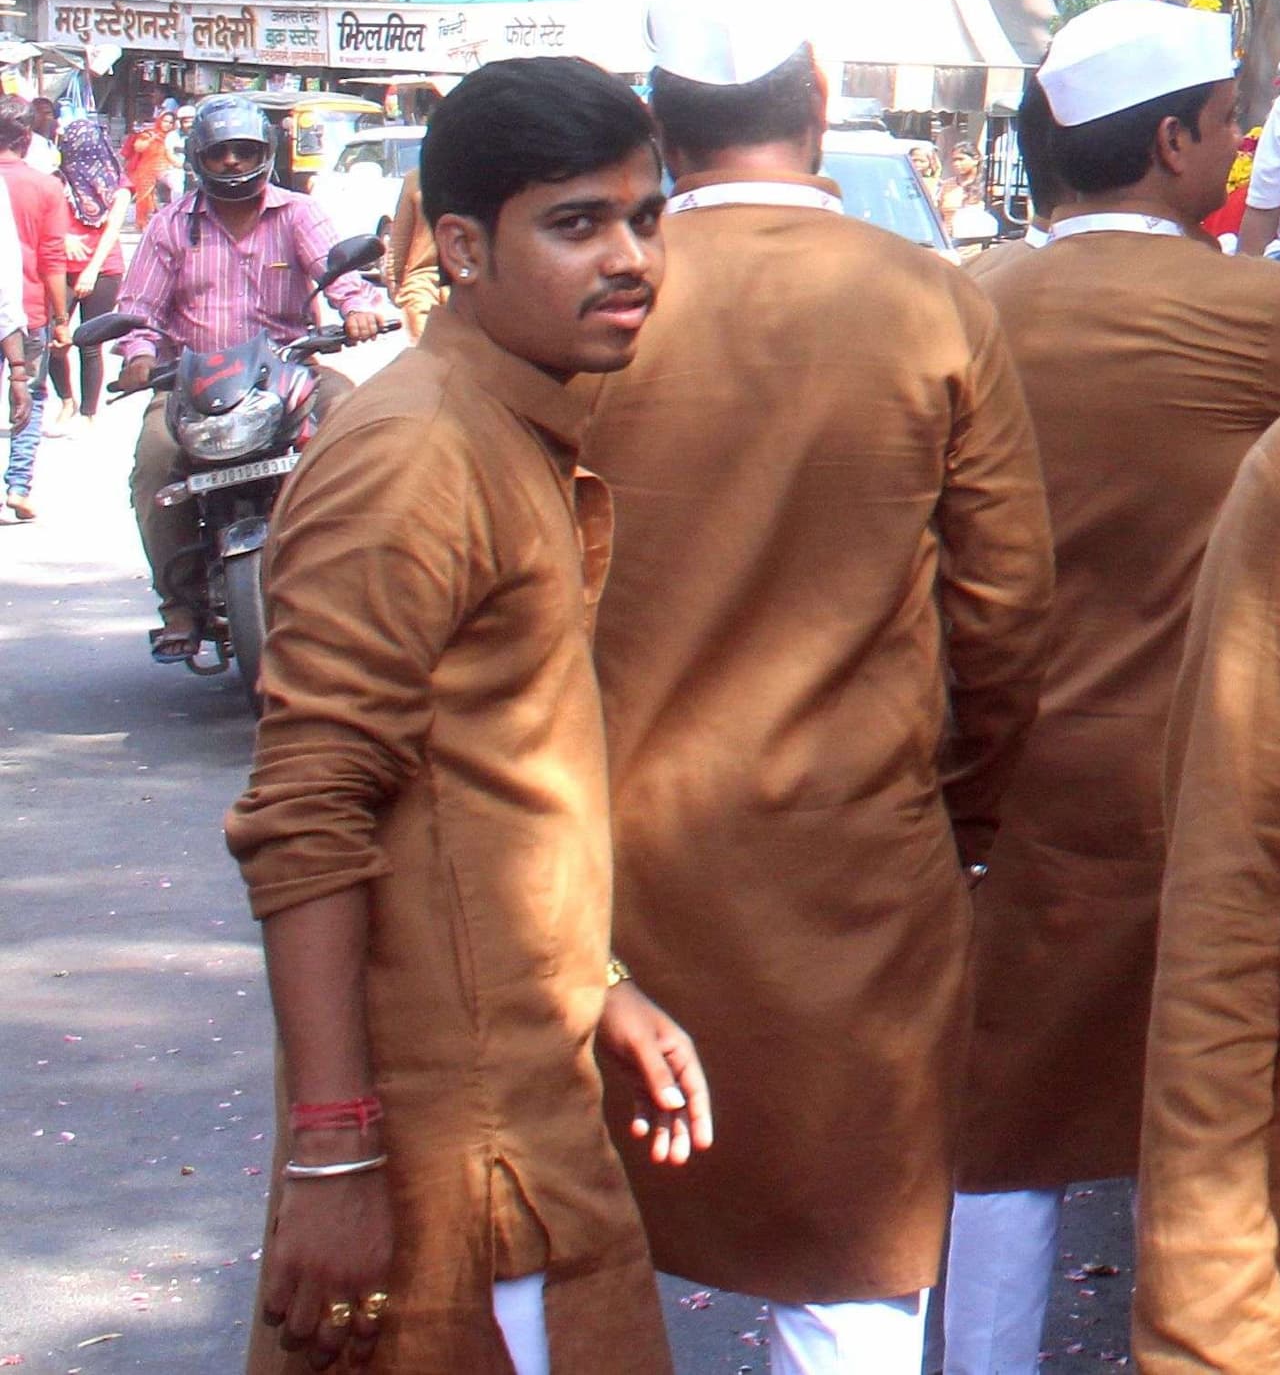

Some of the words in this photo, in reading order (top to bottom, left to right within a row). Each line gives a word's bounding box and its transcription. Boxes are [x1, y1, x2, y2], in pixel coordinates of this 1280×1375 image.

[54, 6, 91, 42] मधु
[192, 4, 257, 50] लक्ष्मी
[288, 25, 320, 47] स्टोर
[505, 17, 537, 46] फोटो
[539, 15, 566, 46] स्टेट
